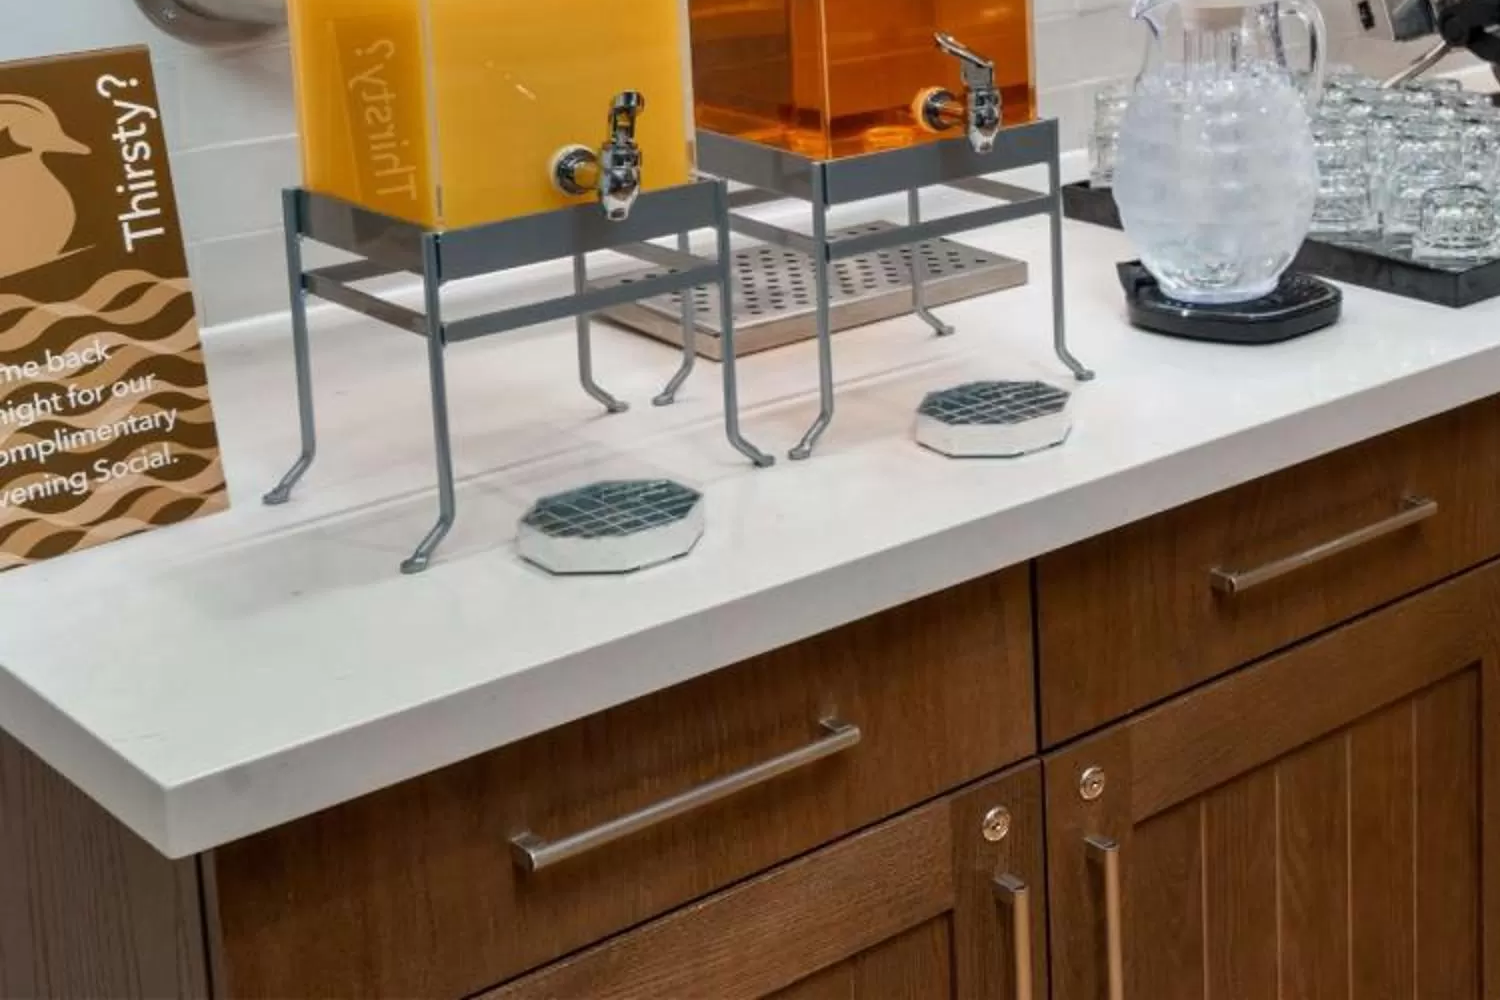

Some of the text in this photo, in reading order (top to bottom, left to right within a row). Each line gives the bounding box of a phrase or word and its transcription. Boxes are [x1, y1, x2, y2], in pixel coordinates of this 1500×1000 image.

[96, 73, 165, 253] Thirsty?
[45, 339, 112, 373] back
[68, 383, 105, 408] for
[112, 373, 156, 398] our
[93, 443, 179, 483] Social.
